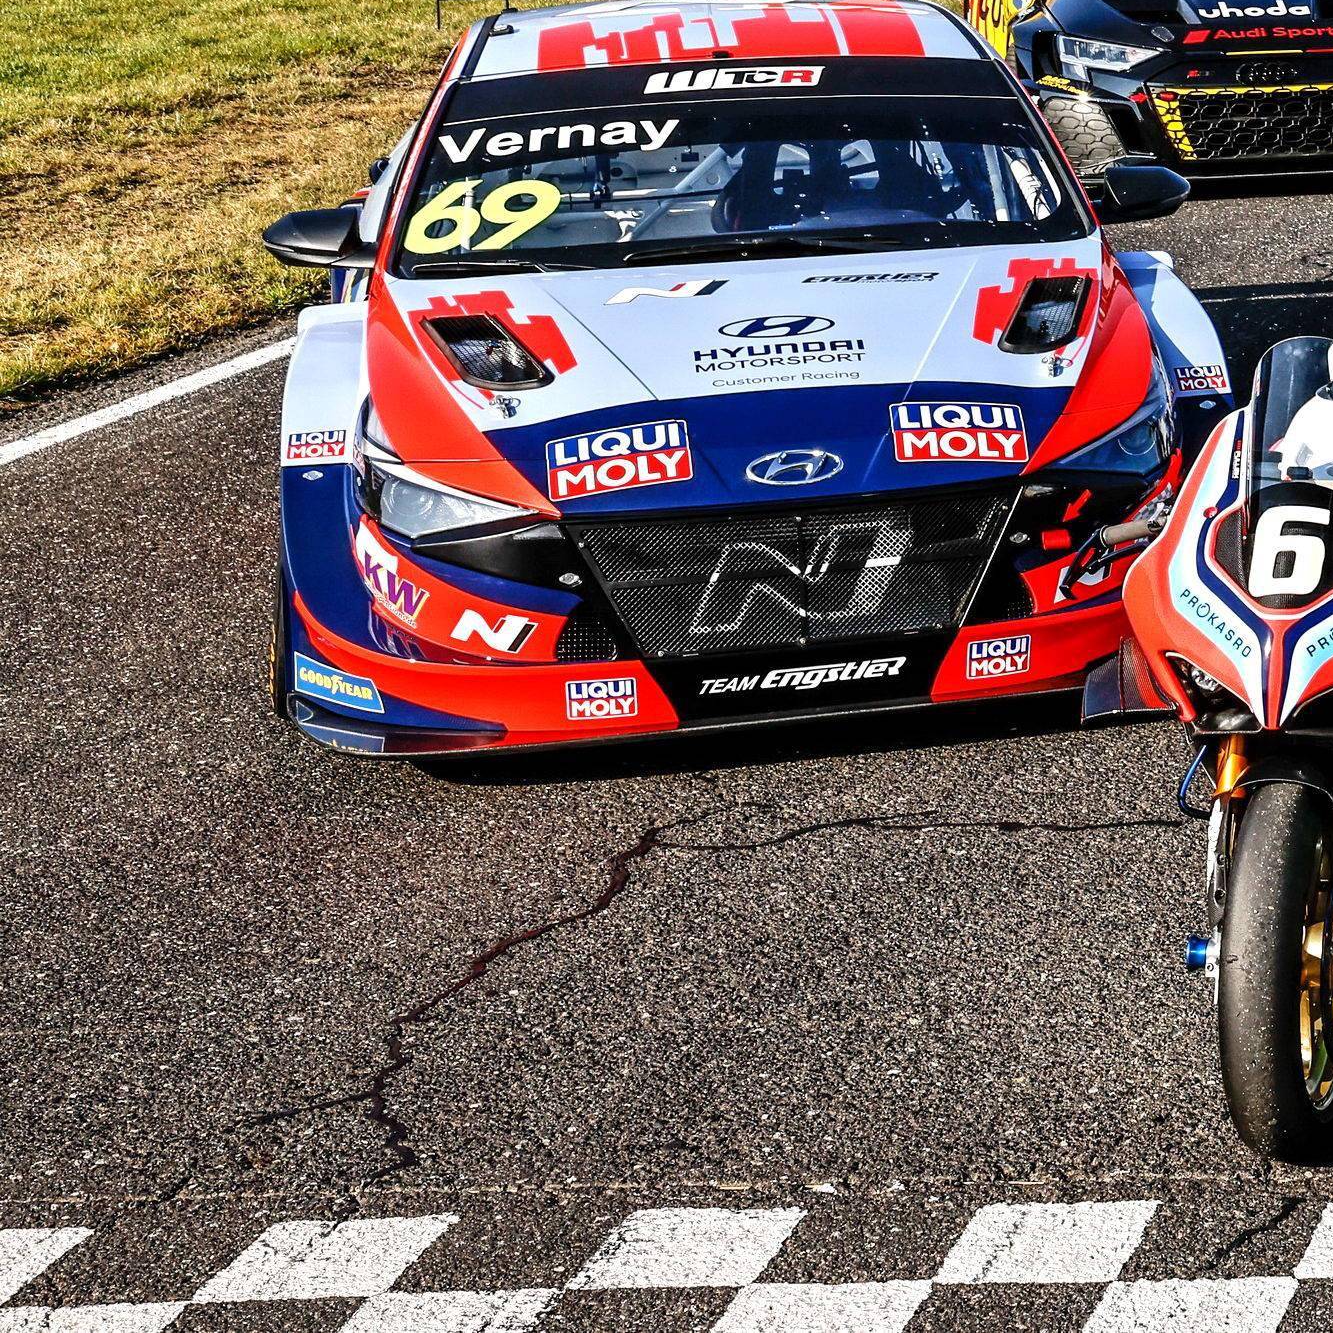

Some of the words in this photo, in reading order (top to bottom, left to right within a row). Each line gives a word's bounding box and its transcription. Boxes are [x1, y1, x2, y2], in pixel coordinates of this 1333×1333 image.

[1198, 0, 1311, 19] uhoda
[1213, 27, 1266, 40] Audi
[643, 66, 824, 94] WTCR
[438, 117, 680, 165] Vernay
[403, 179, 562, 255] 69
[693, 339, 866, 362] HYUNDAI
[695, 352, 867, 373] MOTORSPORT
[1176, 365, 1223, 379] LIQUI
[712, 372, 797, 388] Customer
[801, 369, 861, 382] Racing
[1179, 377, 1226, 392] MOLY
[897, 405, 1022, 430] LIQUI
[290, 430, 345, 446] LIQUI
[551, 423, 687, 468] LIQUI
[897, 430, 1026, 460] MOLY
[288, 442, 345, 459] MOLY
[554, 451, 691, 498] MOLY
[1247, 505, 1331, 598] 6
[363, 550, 430, 617] KW
[969, 640, 1029, 657] LIQUI
[699, 676, 760, 696] TEAM
[760, 656, 907, 691] Engstler
[969, 656, 1029, 678] MOLY
[299, 665, 374, 701] GOODYEAR
[569, 680, 634, 701] LIQUI
[571, 697, 635, 718] MOLY
